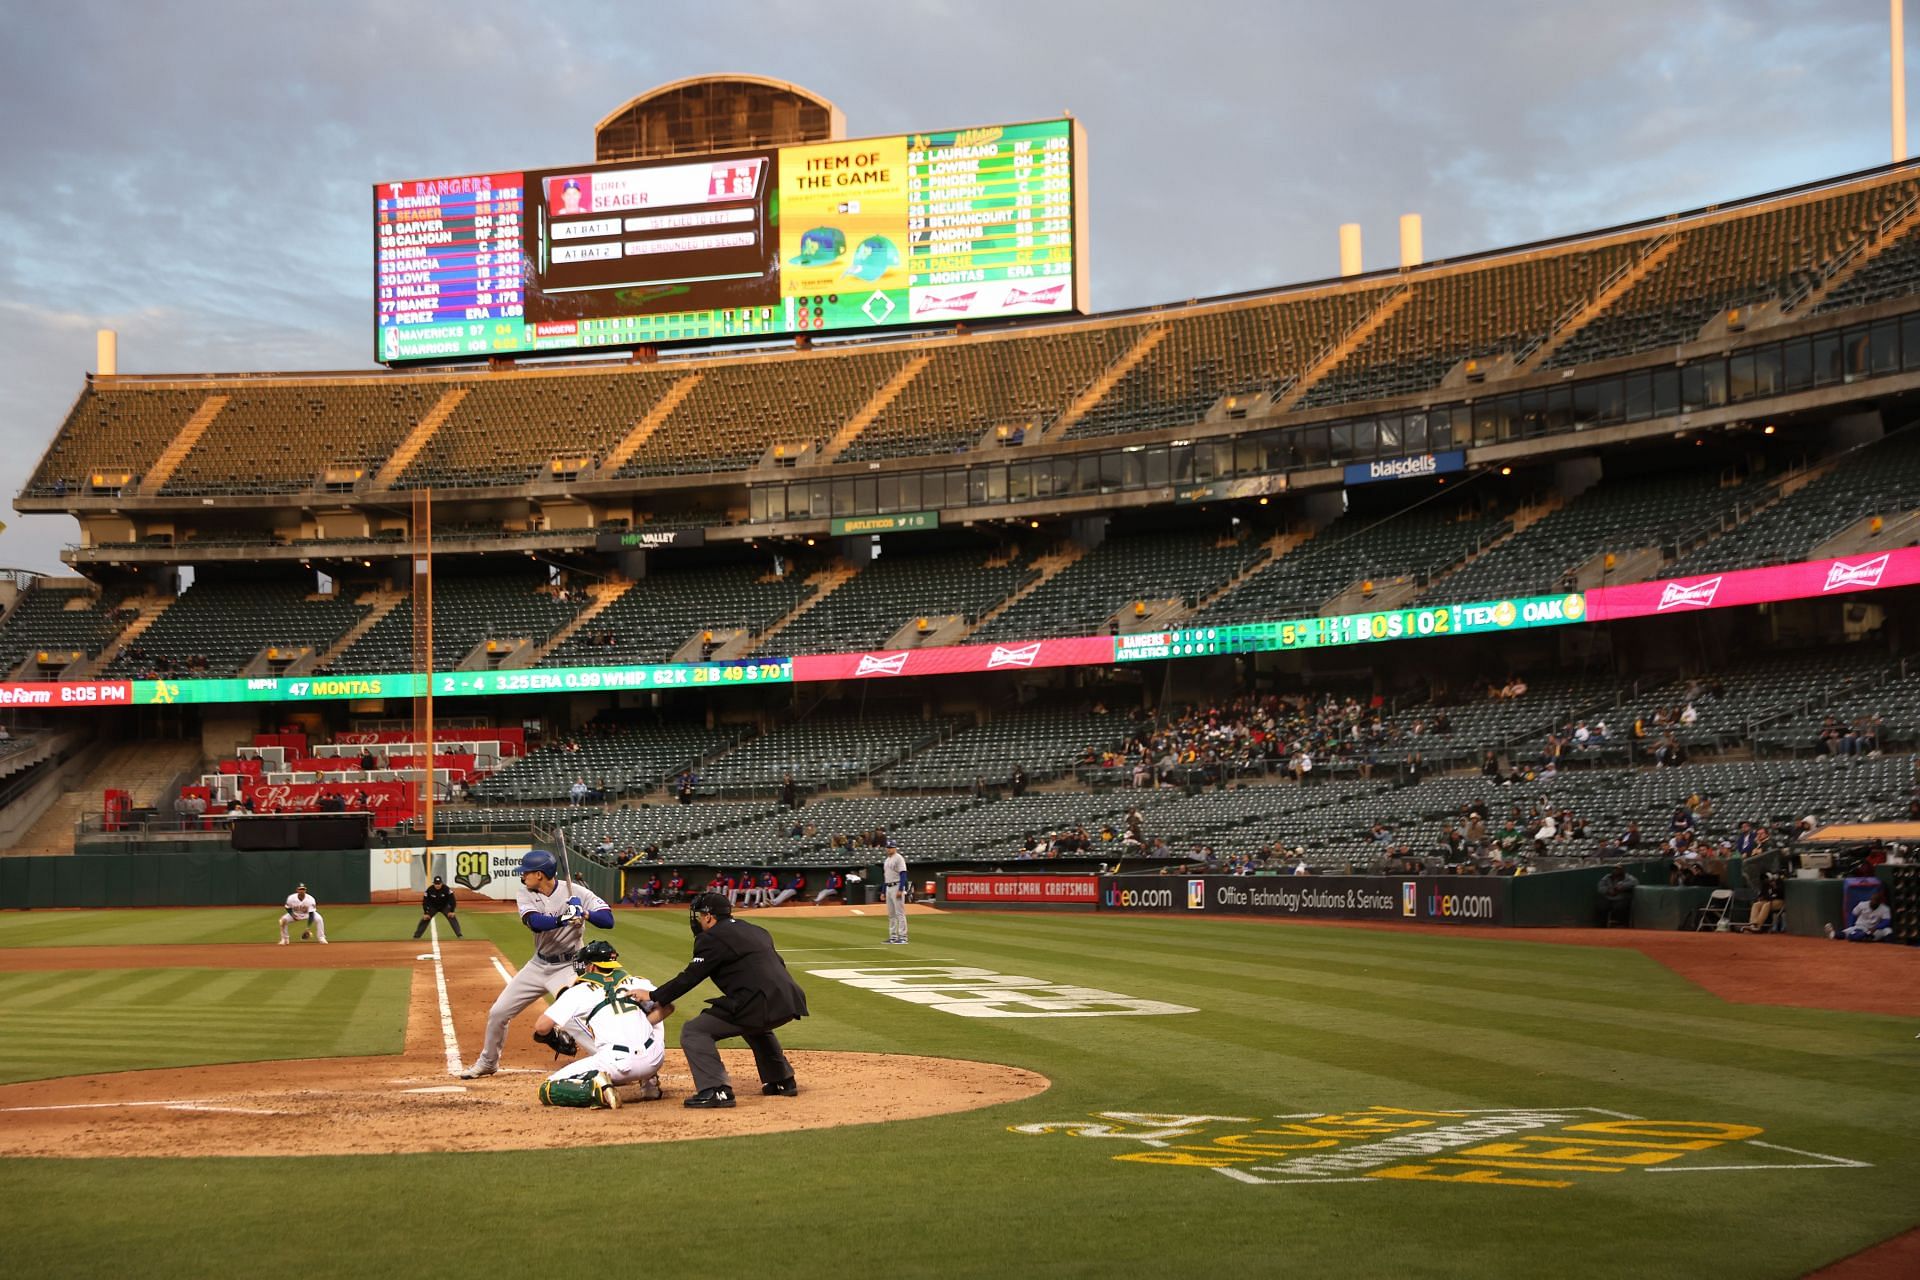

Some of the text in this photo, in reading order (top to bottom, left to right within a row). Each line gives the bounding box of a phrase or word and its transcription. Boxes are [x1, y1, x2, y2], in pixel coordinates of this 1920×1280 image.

[928, 144, 998, 160] LAUREANO
[807, 153, 880, 171] ITEM OF
[416, 176, 491, 197] RANGERS
[797, 169, 890, 189] THE GAME
[594, 192, 648, 208] SEAGER
[929, 186, 985, 200] MURPHY
[396, 195, 441, 208] SEMIEN
[396, 208, 442, 222] SEAGER
[929, 210, 1014, 227] BETHANCOURT
[396, 215, 492, 234] GARVER DH
[565, 226, 577, 234] AT
[396, 231, 452, 246] CALHOUN
[475, 228, 491, 240] RF
[909, 226, 983, 242] 17 ANDRUS
[396, 246, 427, 260] HEIM
[479, 241, 488, 252] C
[565, 250, 576, 258] AT
[396, 258, 440, 271] GARCIA
[476, 254, 491, 265] CF
[396, 271, 431, 285] LOWE
[929, 270, 985, 285] MONTAS
[381, 287, 393, 299] 13
[396, 283, 440, 297] MILLER
[476, 279, 492, 291] LF
[381, 297, 440, 312] 77 IBANEZ
[381, 307, 490, 325] P PEREZ ERA
[400, 326, 464, 340] MAVERICKS
[537, 324, 576, 335] RANGERS
[400, 341, 460, 355] WARRIORS
[1830, 567, 1881, 582] Budweiser
[1463, 607, 1498, 627] TEX
[1524, 600, 1563, 621] OAK
[1123, 634, 1164, 648] RANGERS
[1282, 625, 1295, 645] 5
[1117, 646, 1169, 660] ATHLETICS
[248, 679, 277, 690] MPH
[289, 683, 308, 695] 47
[312, 680, 381, 695] MONTAS
[444, 678, 455, 692] 2
[473, 677, 485, 690] 4
[496, 675, 529, 690] 3.25
[531, 674, 563, 688] ERA
[602, 671, 646, 687] WHIP
[653, 669, 673, 684] 62
[675, 669, 688, 683] K
[709, 667, 720, 682] B
[723, 666, 743, 680] 49
[746, 665, 757, 680] S
[760, 664, 780, 679] 70
[781, 663, 792, 677] T
[61, 686, 96, 700] 8:05
[101, 686, 125, 699] PM
[150, 679, 179, 703] A's
[457, 851, 488, 876] 811
[493, 857, 523, 866] Before
[493, 870, 510, 879] you
[947, 882, 990, 895] CRAFTSMAN
[994, 882, 1041, 895] CRAFTSMAN
[1045, 883, 1095, 896] CRAFTSMAN
[1105, 883, 1172, 907] ubeo.com
[1217, 886, 1248, 906] Office
[1249, 888, 1301, 912] Technology
[1301, 888, 1345, 908] Solutions
[1347, 889, 1356, 908] &
[1357, 889, 1394, 910] Services
[1428, 881, 1492, 918] ubeo.com
[1006, 1111, 1260, 1141] 24
[1112, 1105, 1468, 1168] RICKEY
[1250, 1112, 1583, 1177] HENDERSON
[1361, 1119, 1764, 1189] FIELD
